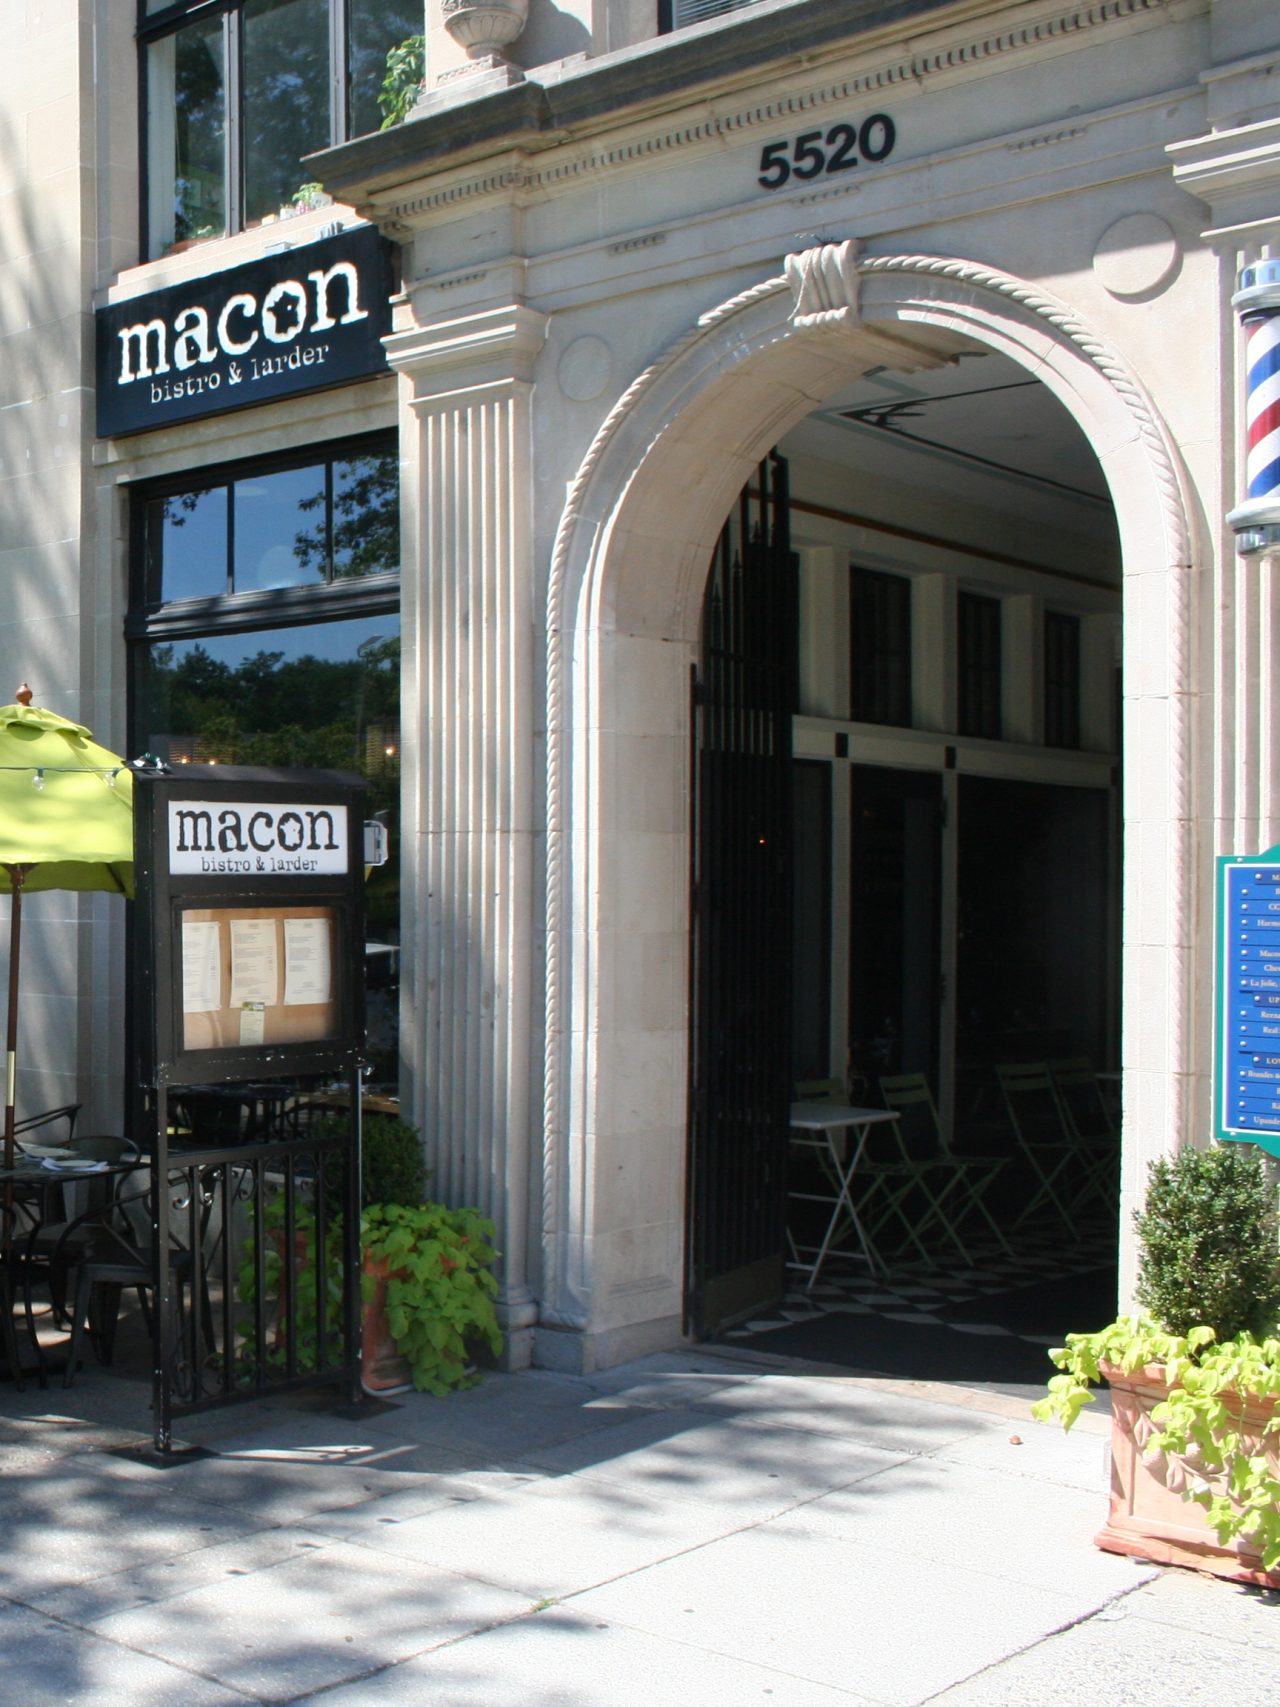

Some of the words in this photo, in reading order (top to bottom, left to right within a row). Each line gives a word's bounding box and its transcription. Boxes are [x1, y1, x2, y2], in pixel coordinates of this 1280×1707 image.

[758, 113, 896, 190] 5520
[117, 261, 369, 384] macon
[150, 369, 220, 403] bistro
[228, 362, 243, 385] &
[251, 344, 329, 381] larder
[176, 810, 340, 852] macon
[202, 856, 251, 872] bistro
[256, 856, 265, 872] &
[270, 855, 318, 872] larder
